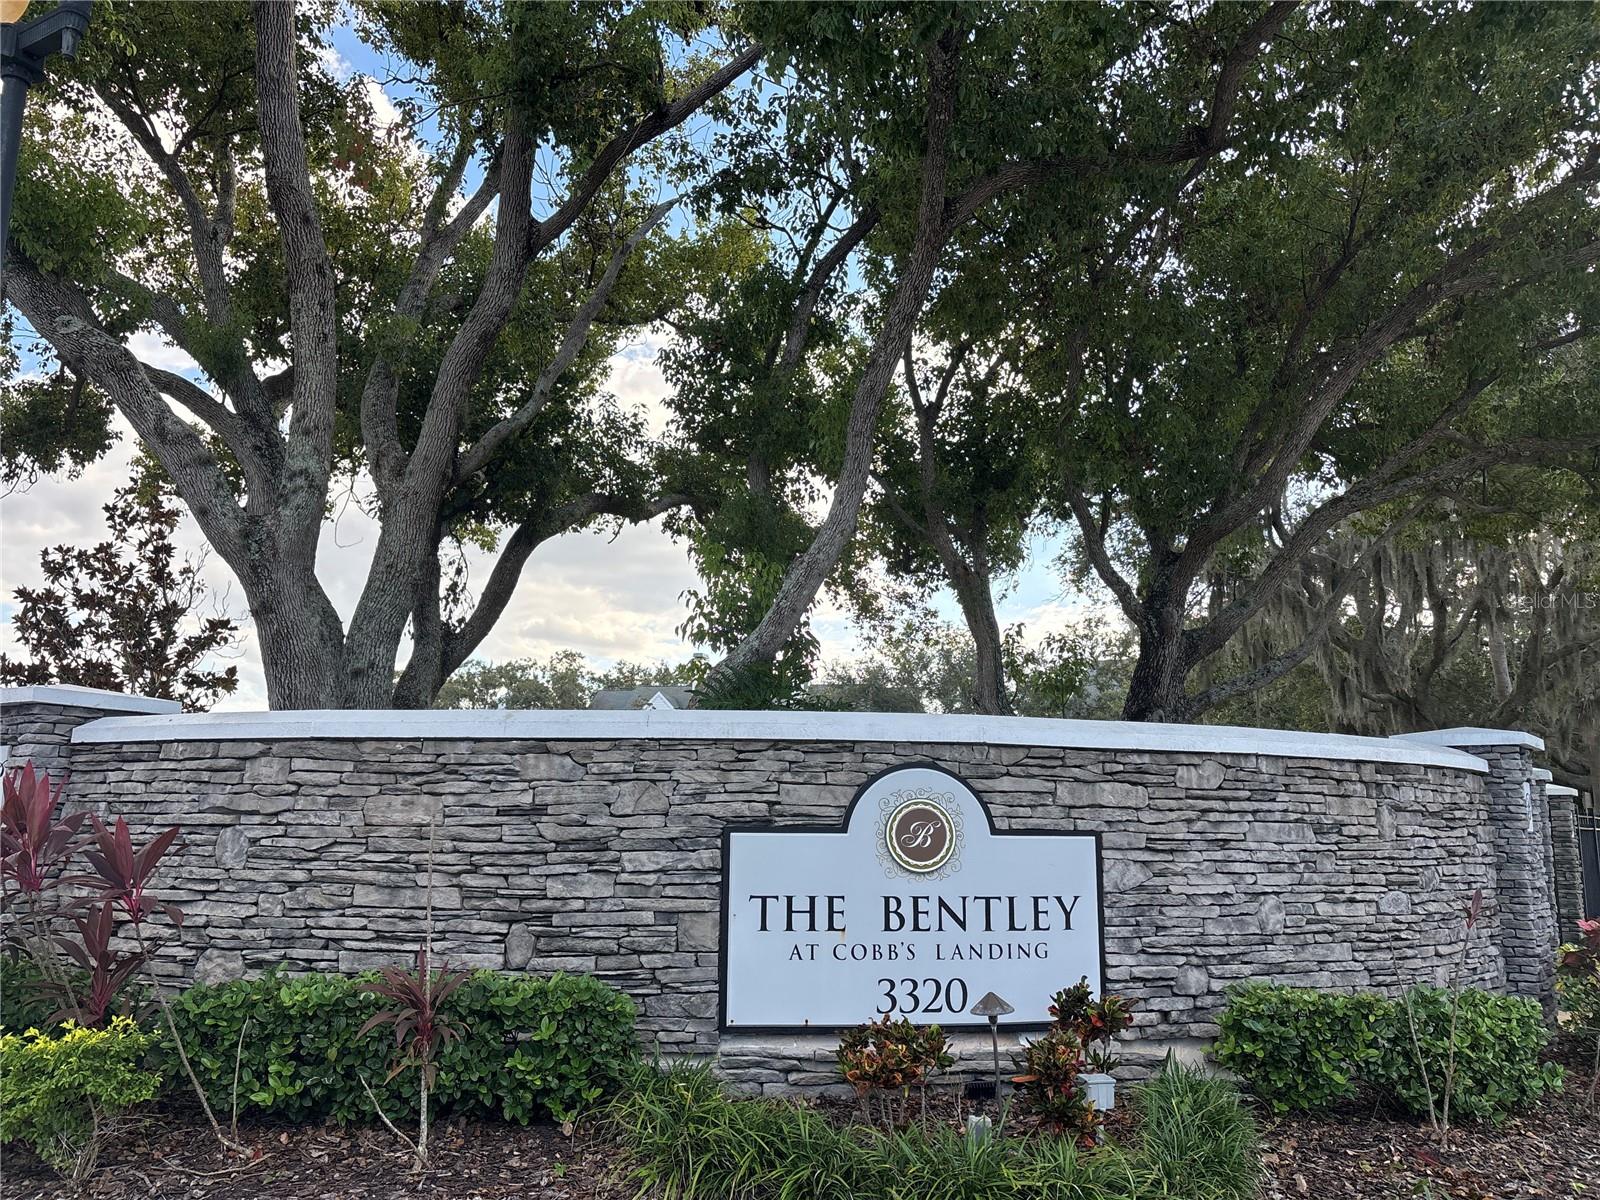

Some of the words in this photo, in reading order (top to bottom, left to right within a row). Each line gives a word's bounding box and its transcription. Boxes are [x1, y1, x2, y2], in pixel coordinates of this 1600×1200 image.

[900, 820, 941, 848] B
[748, 895, 847, 932] THE
[881, 895, 1081, 932] BENTLEY
[789, 943, 820, 961] AT
[832, 941, 916, 961] COBB'S
[936, 942, 1048, 961] LANDING
[876, 977, 968, 1014] 3320
